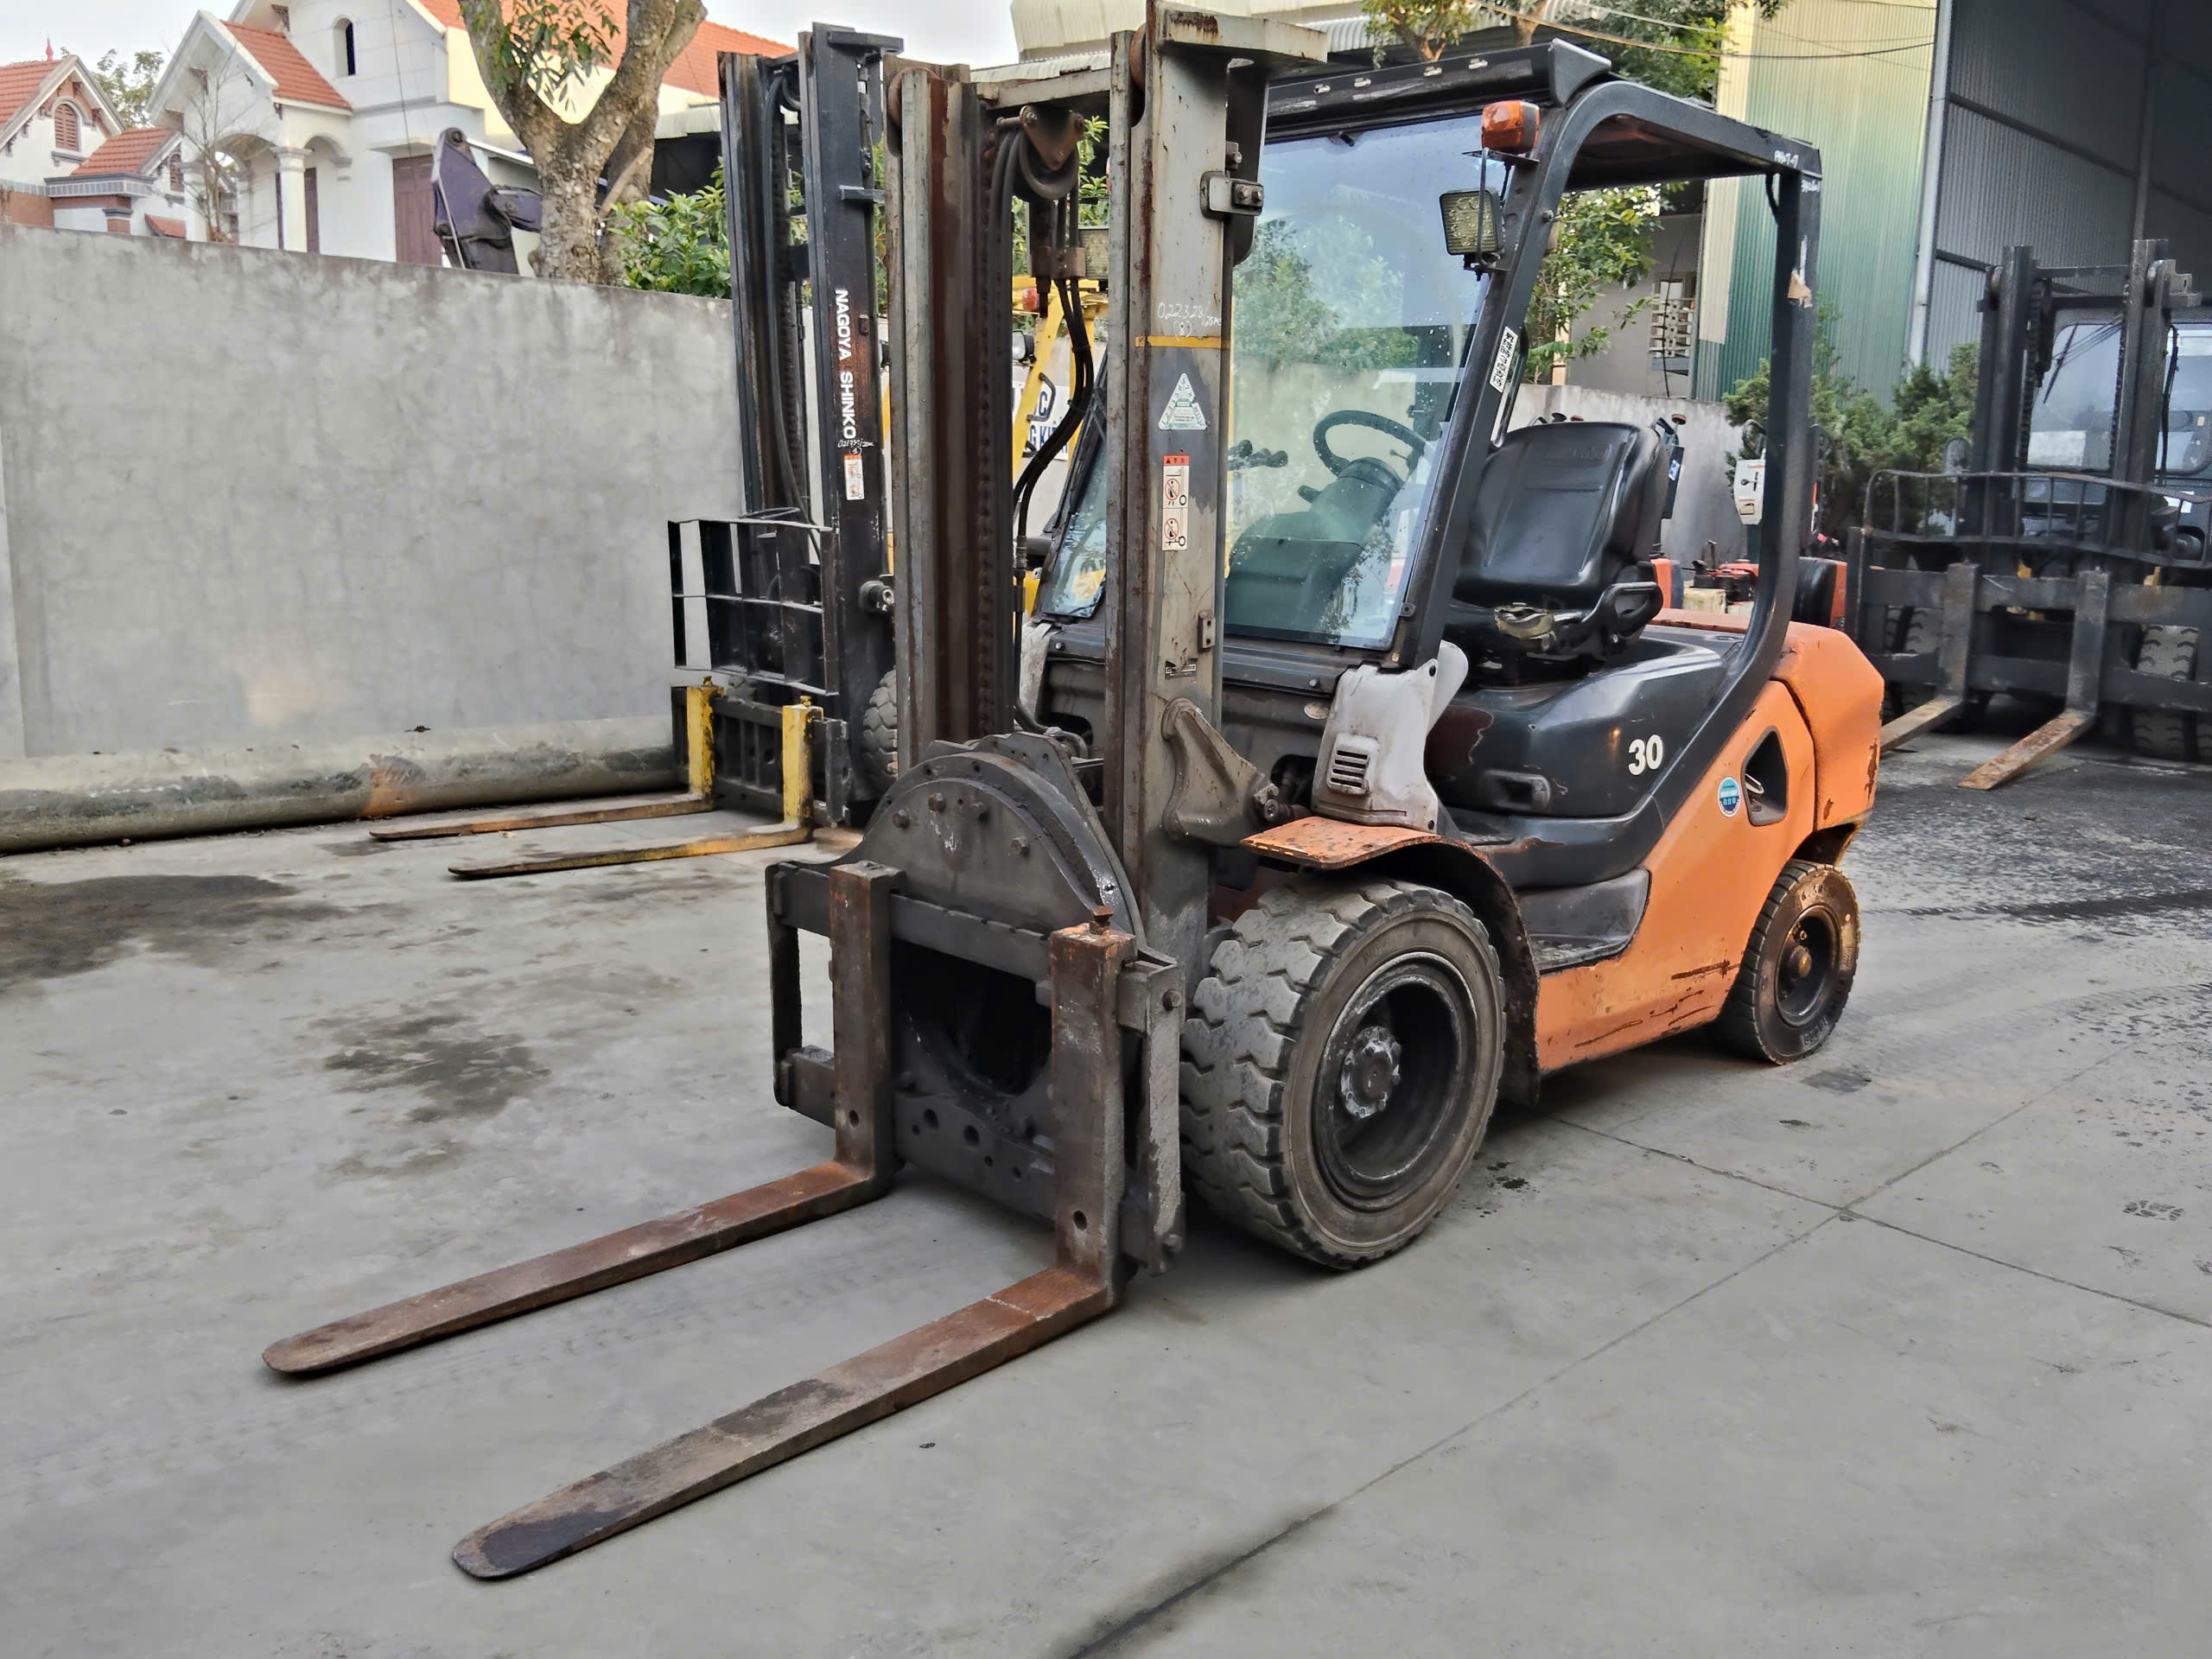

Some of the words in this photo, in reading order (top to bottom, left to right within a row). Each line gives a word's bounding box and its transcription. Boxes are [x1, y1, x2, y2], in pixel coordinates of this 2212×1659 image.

[836, 290, 851, 360] NAGOYA
[840, 372, 856, 439] SHINKO
[1629, 734, 1662, 775] 30
